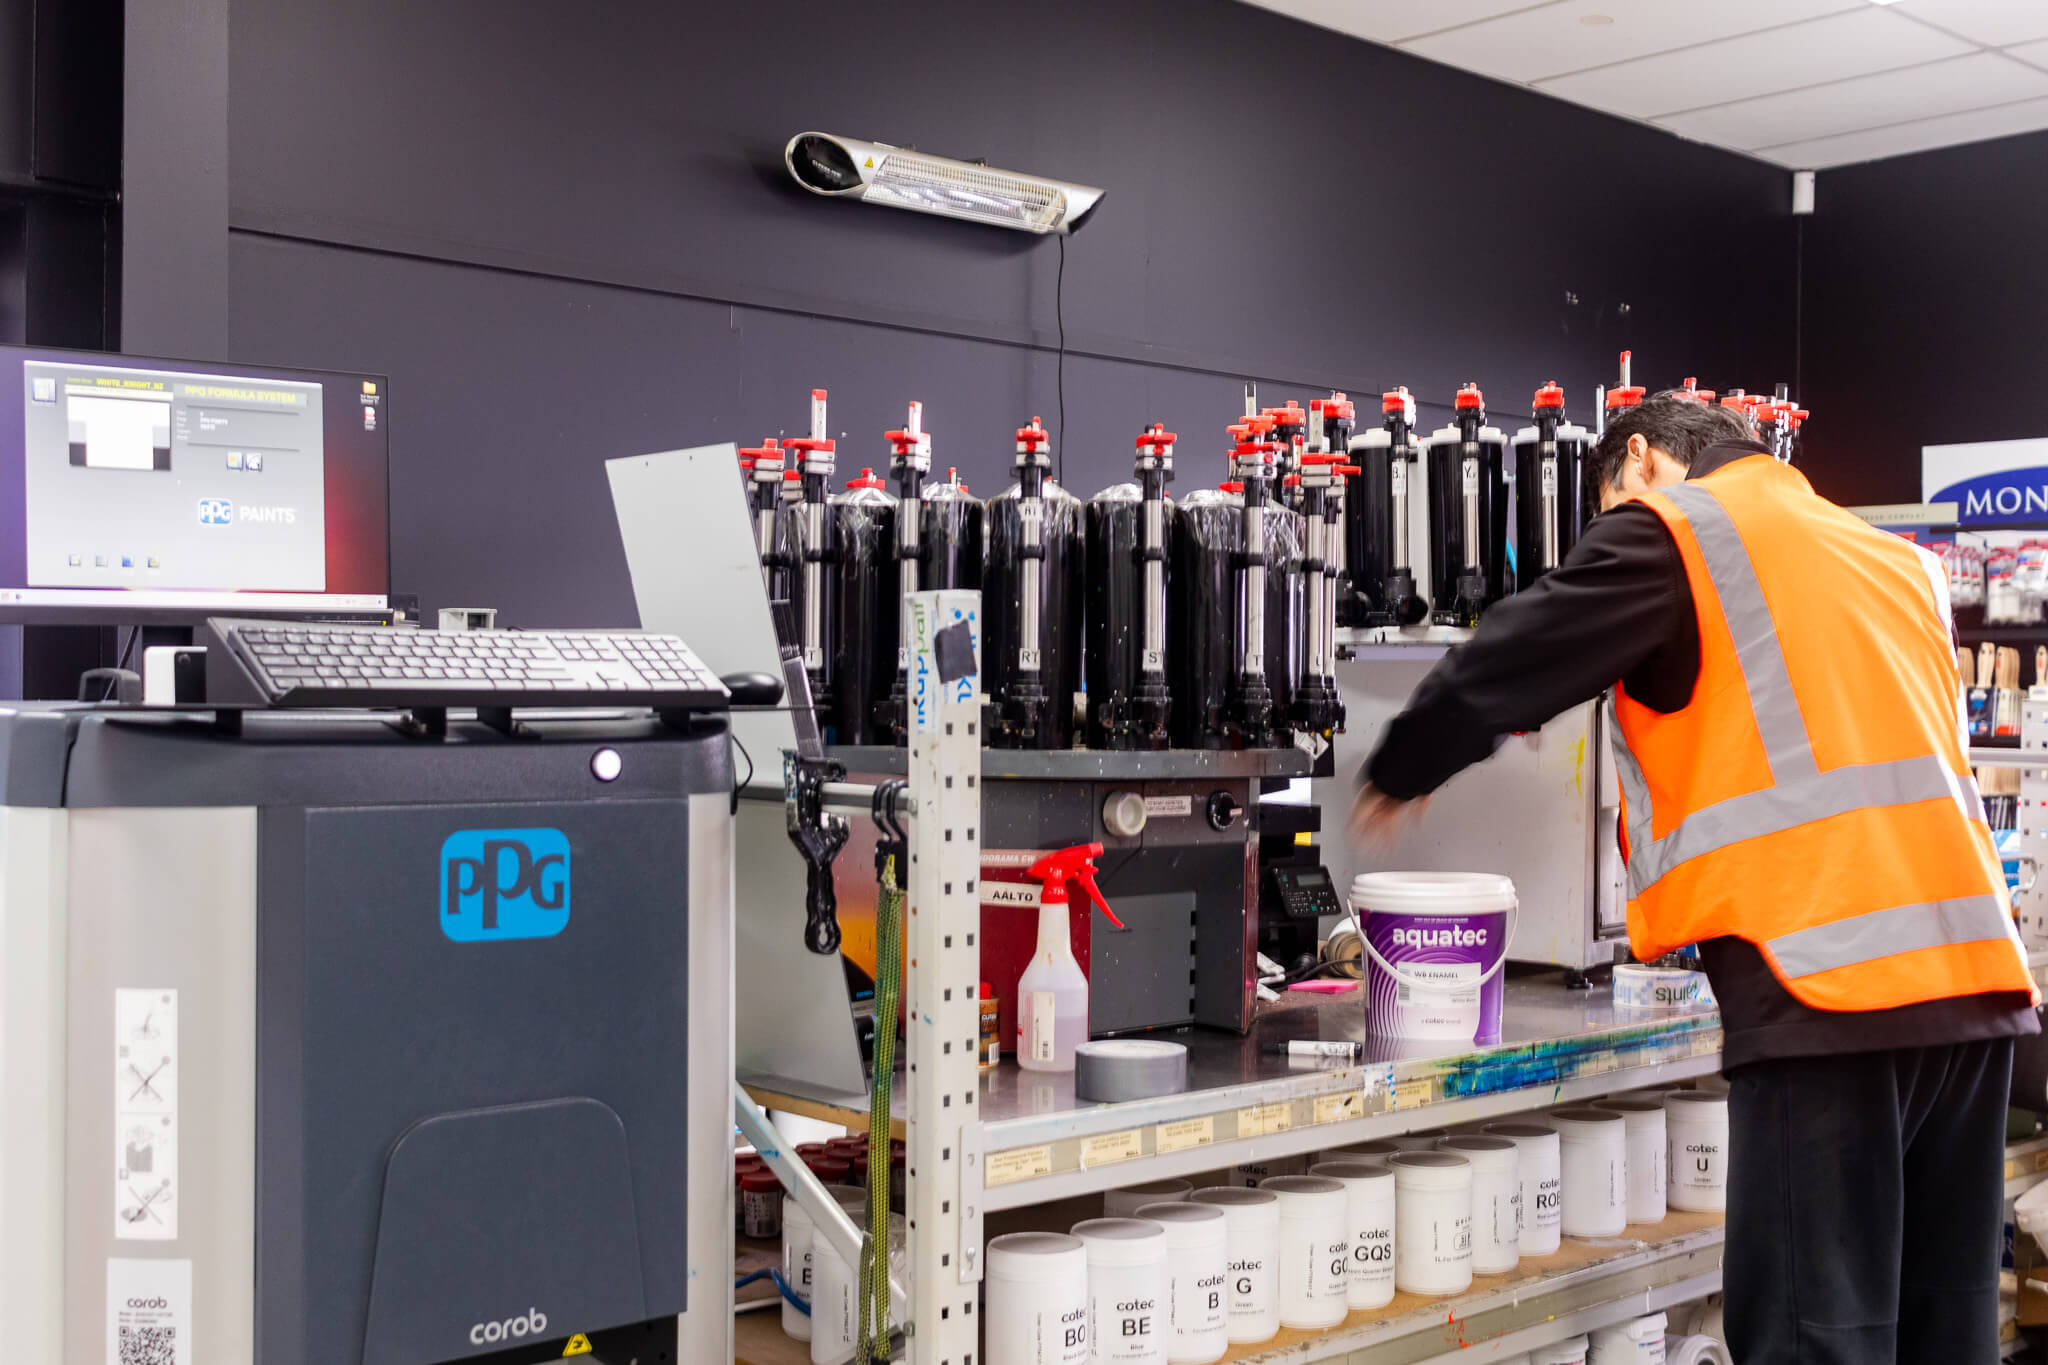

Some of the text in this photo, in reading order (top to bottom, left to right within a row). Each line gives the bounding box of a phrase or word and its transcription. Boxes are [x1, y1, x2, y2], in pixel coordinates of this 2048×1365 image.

[200, 501, 296, 524] PPG PAINTS
[447, 839, 565, 931] PPG
[992, 890, 1033, 902] AALTO
[1392, 924, 1488, 951] aquatec
[1686, 1143, 1719, 1153] cotec
[1696, 1157, 1709, 1172] U
[1360, 1227, 1391, 1240] cotec
[1354, 1242, 1392, 1263] GQS
[1236, 1276, 1252, 1295] G
[127, 1295, 168, 1309] corob
[1116, 1297, 1156, 1312] cotec
[1208, 1291, 1220, 1310] B
[469, 1306, 548, 1345] corob
[1122, 1315, 1152, 1337] BE
